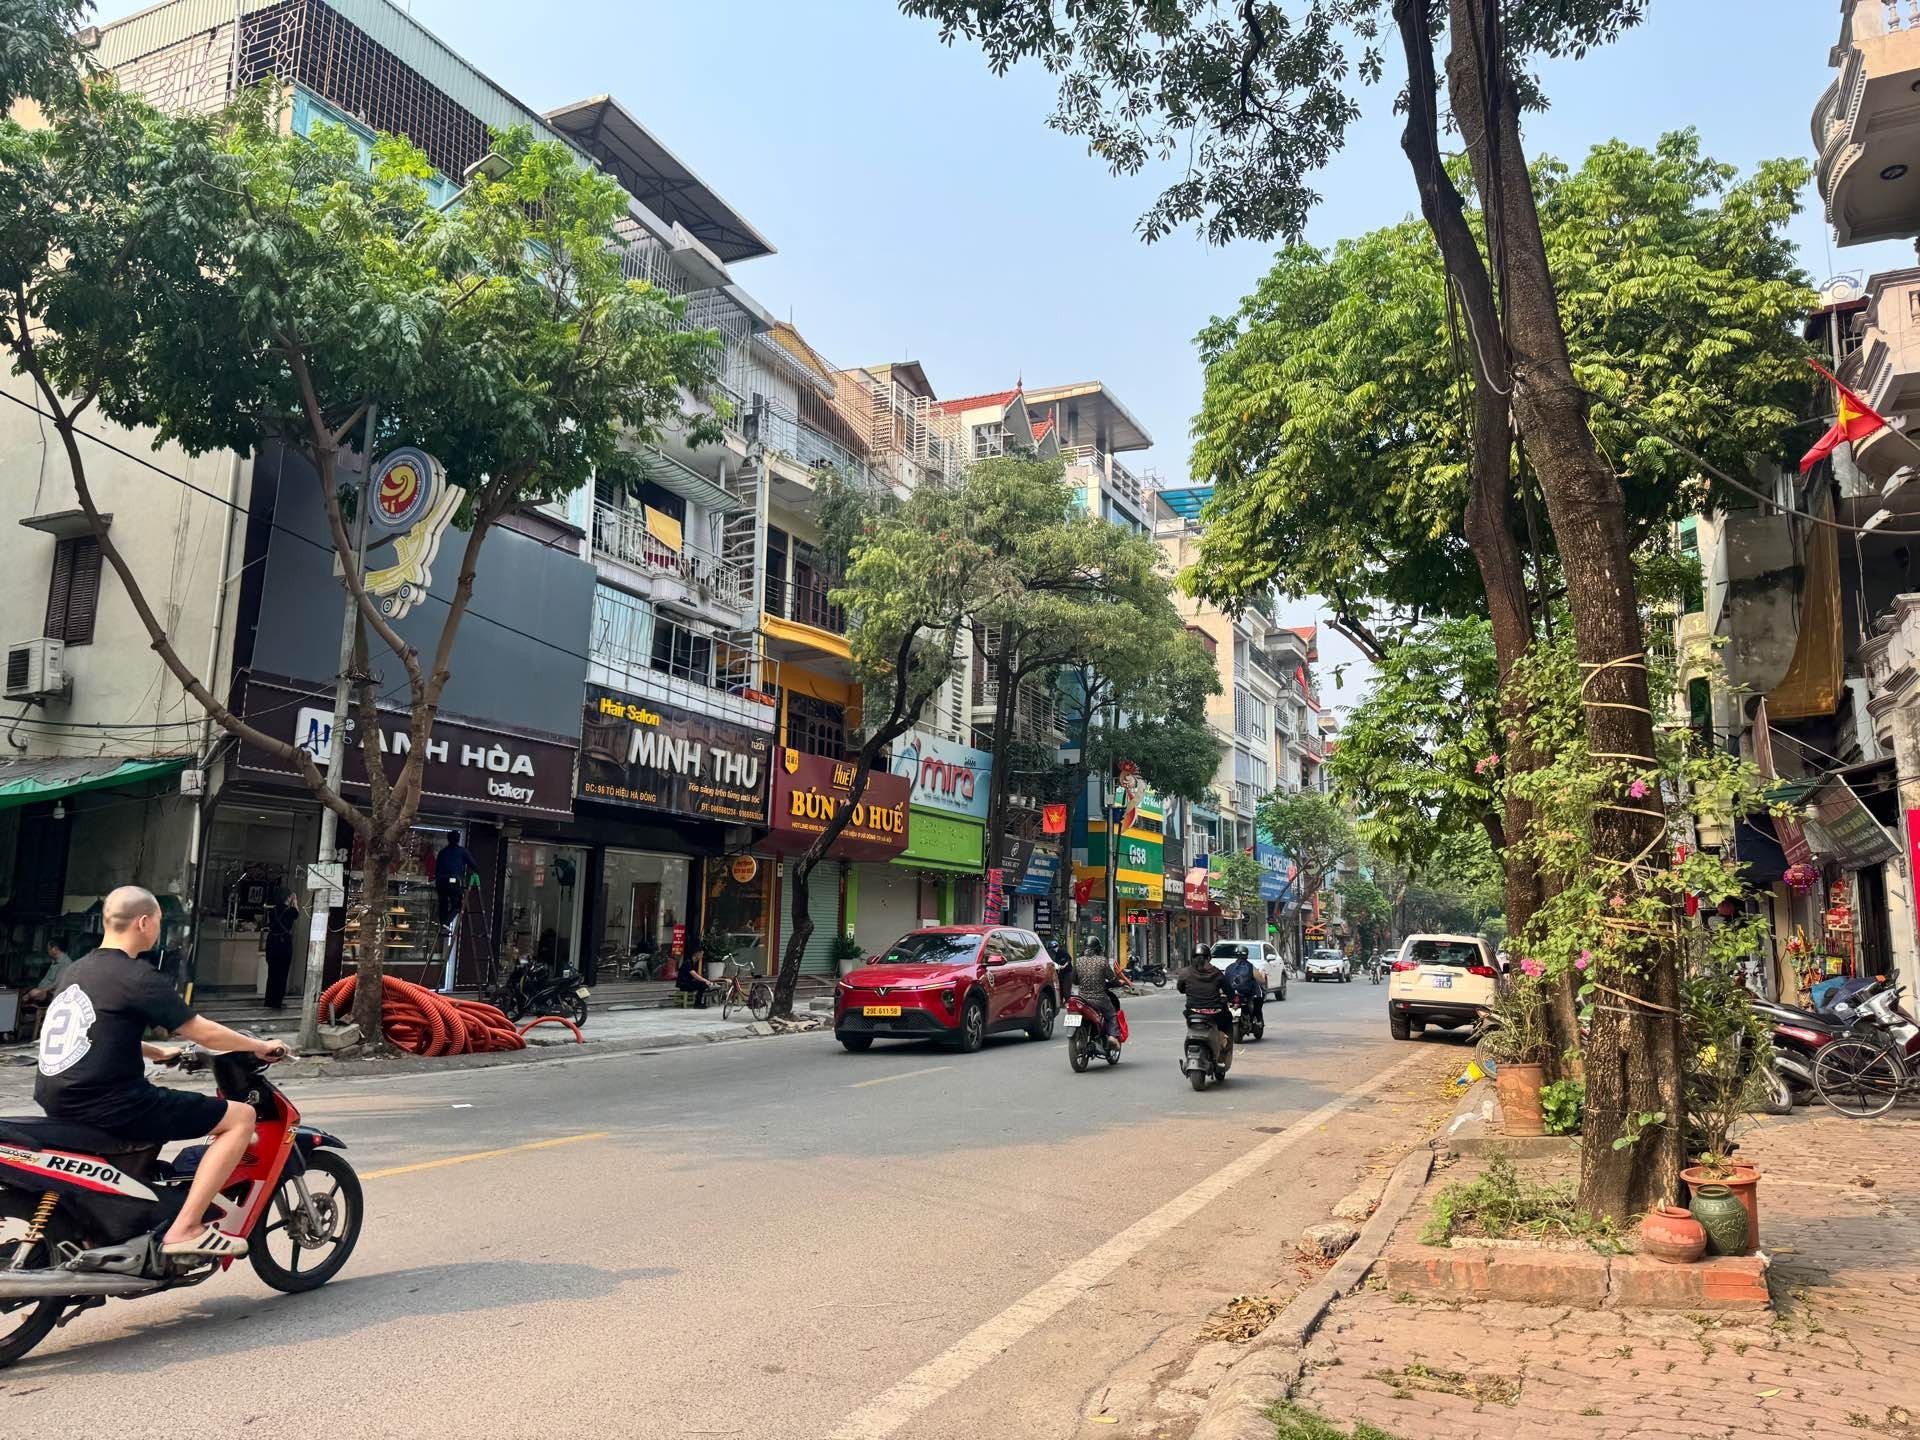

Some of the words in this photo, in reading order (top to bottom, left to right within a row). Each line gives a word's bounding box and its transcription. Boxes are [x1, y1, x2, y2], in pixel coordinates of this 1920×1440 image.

[600, 698, 626, 716] Hair
[626, 704, 660, 727] Salon
[461, 744, 535, 777] HÒA
[628, 728, 702, 777] MINH
[710, 747, 758, 789] THU
[921, 756, 975, 799] mira
[487, 778, 535, 803] bakery
[791, 786, 836, 821] BÚN
[869, 801, 905, 834] HUẾ
[45, 1008, 72, 1055] 2
[47, 1155, 121, 1185] REPSOL
